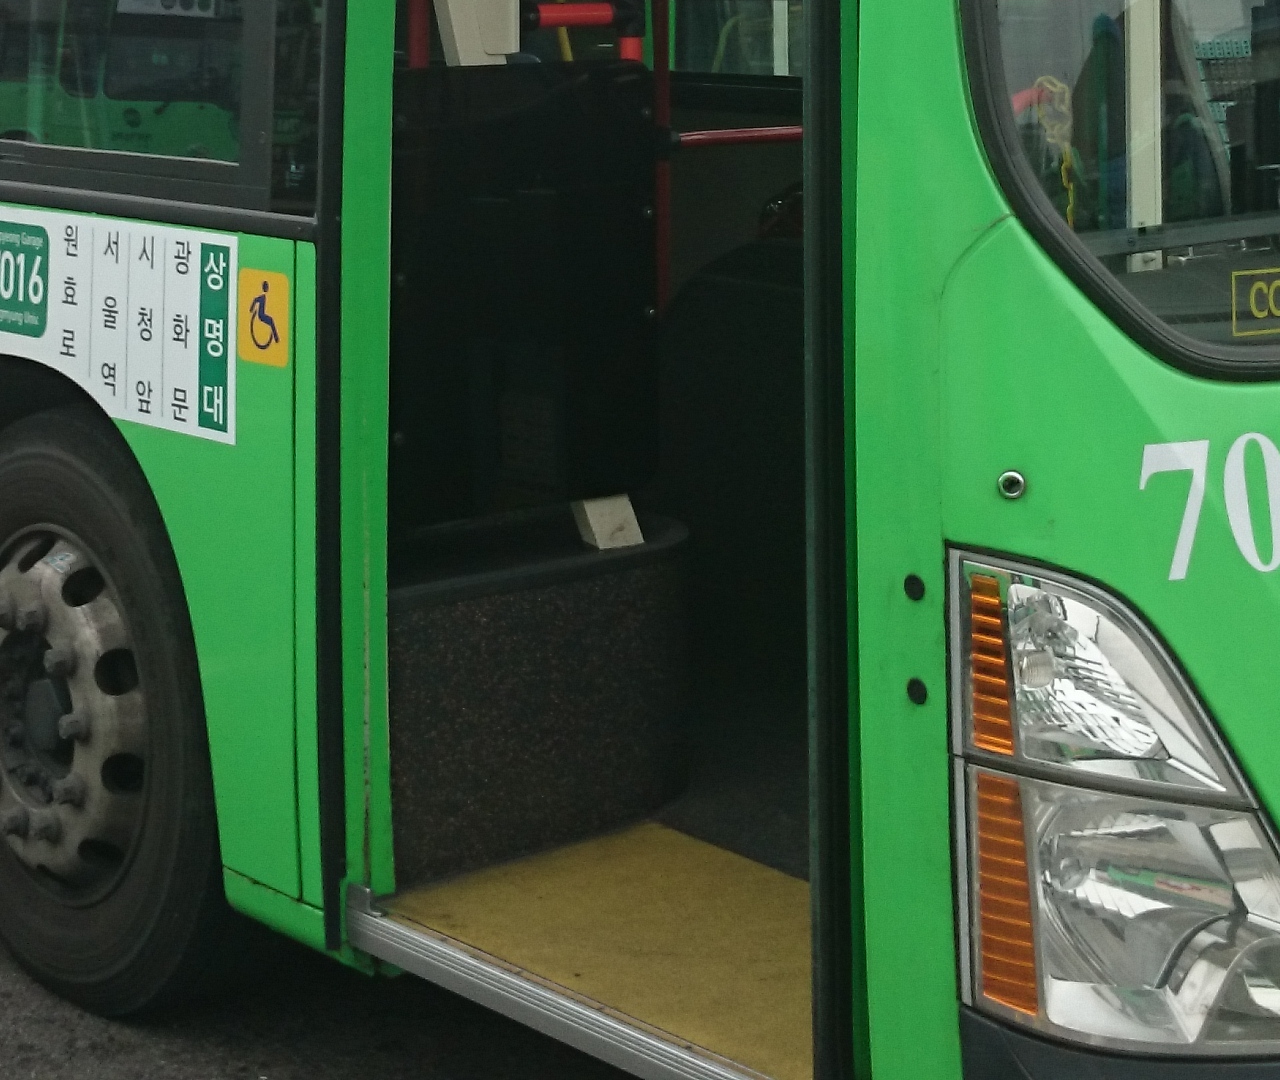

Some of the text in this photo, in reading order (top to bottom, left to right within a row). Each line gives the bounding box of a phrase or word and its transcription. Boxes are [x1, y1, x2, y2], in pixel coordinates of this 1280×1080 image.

[59, 224, 79, 358] 원효로
[100, 230, 120, 397] 서울역
[135, 235, 155, 415] 시청앞
[170, 240, 192, 423] 광화문
[202, 251, 227, 425] 상명대
